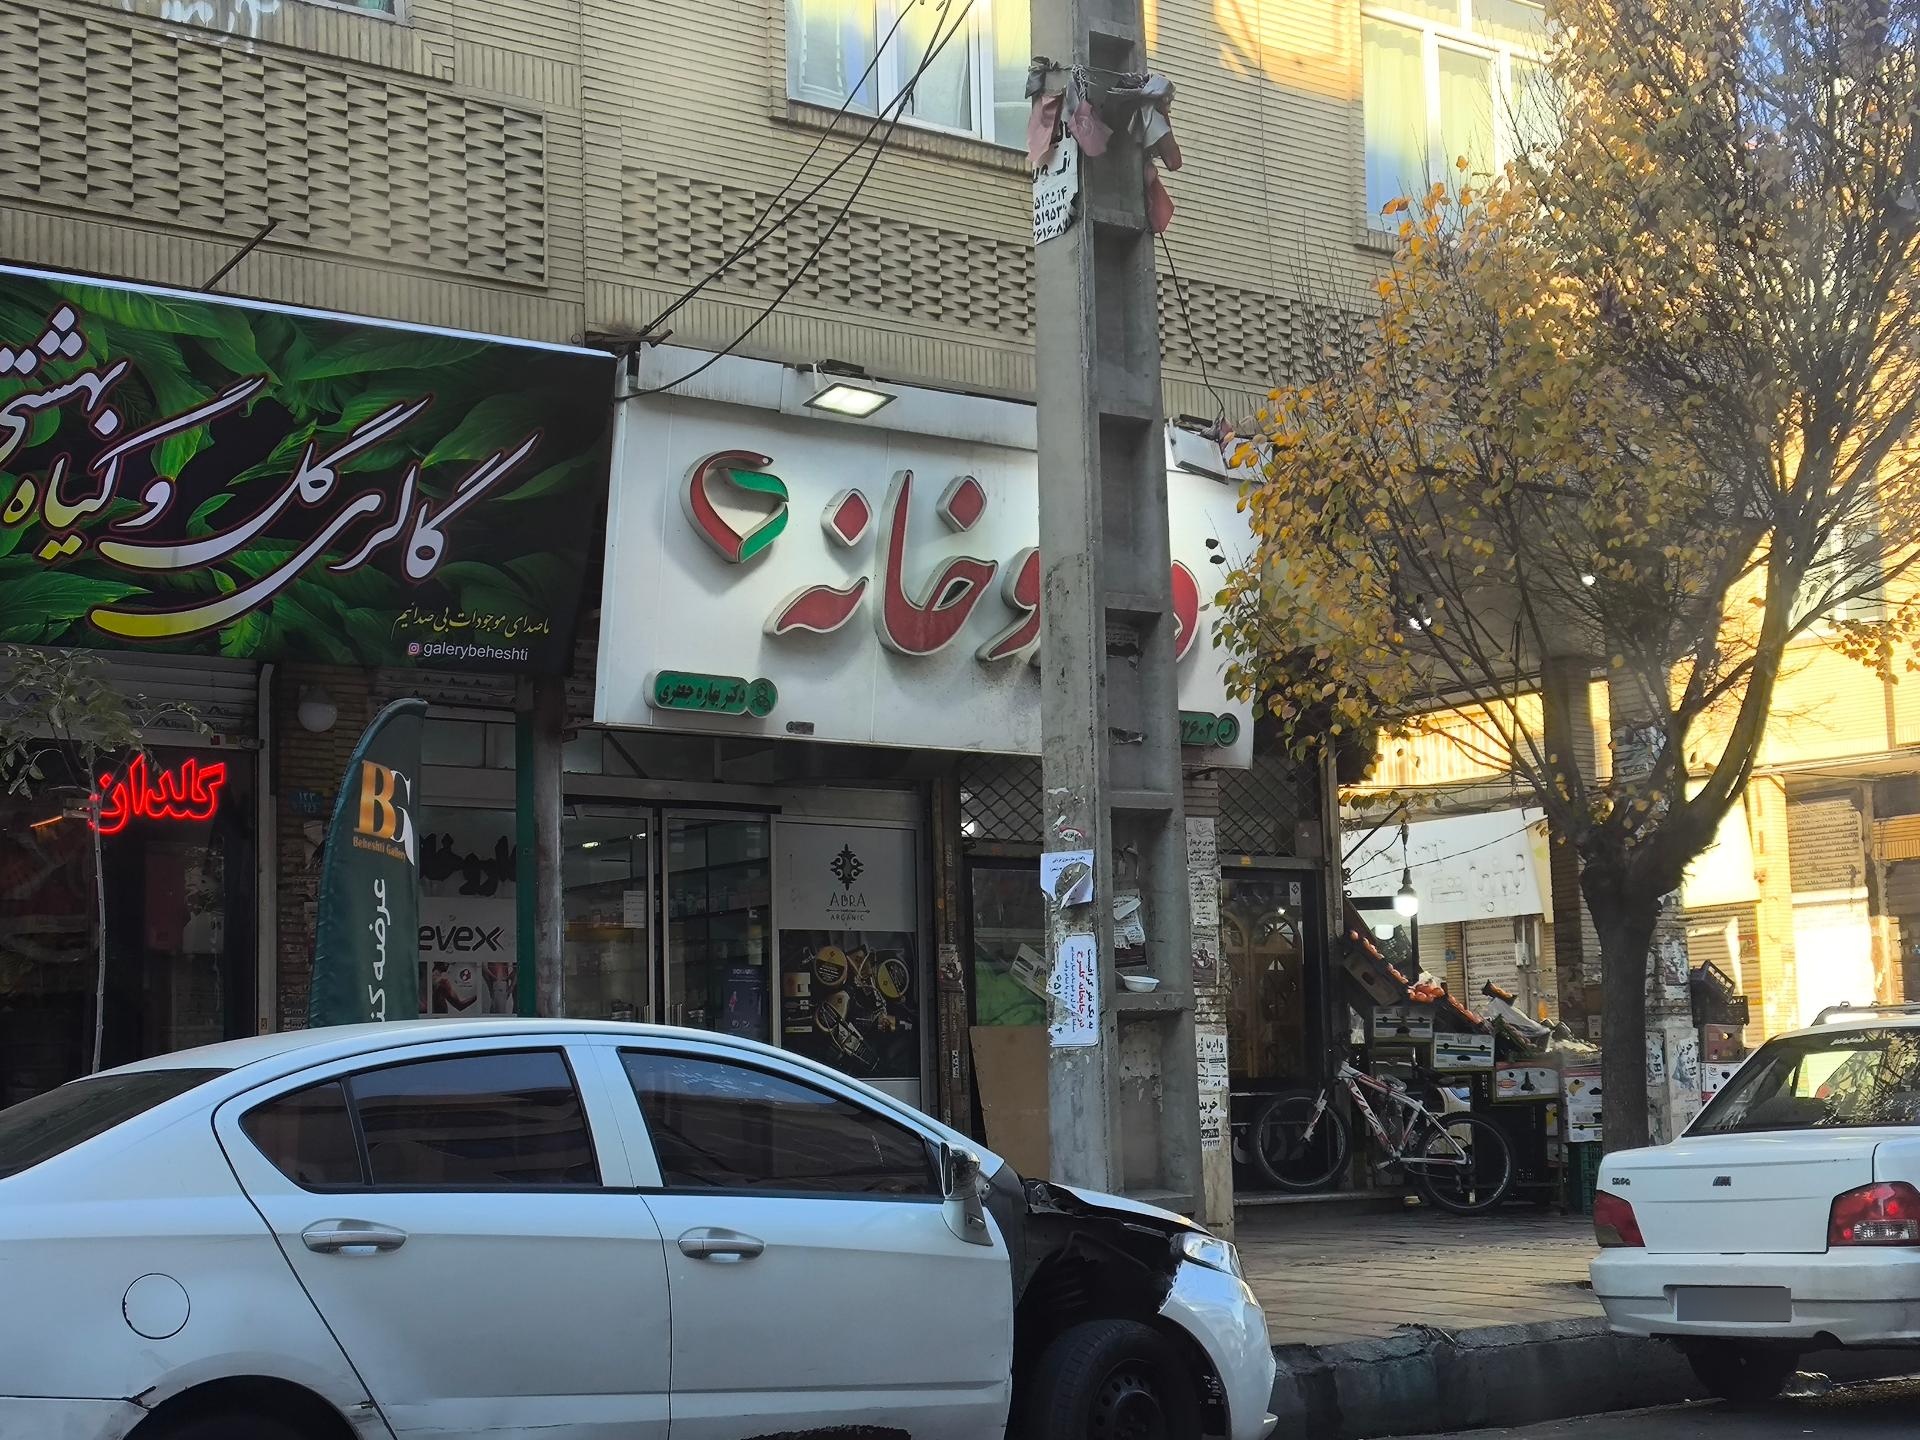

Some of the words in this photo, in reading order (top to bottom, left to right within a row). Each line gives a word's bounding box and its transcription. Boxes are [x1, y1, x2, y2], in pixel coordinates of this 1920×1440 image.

[3, 376, 268, 561] گیاه
[98, 395, 432, 570] گل
[114, 479, 176, 528] و
[90, 432, 543, 640] گالری
[449, 610, 506, 632] موجودات
[423, 641, 529, 662] galerybeheshti
[352, 835, 385, 854] Beheshti
[368, 878, 392, 980] عرضه
[418, 925, 505, 952] evex
